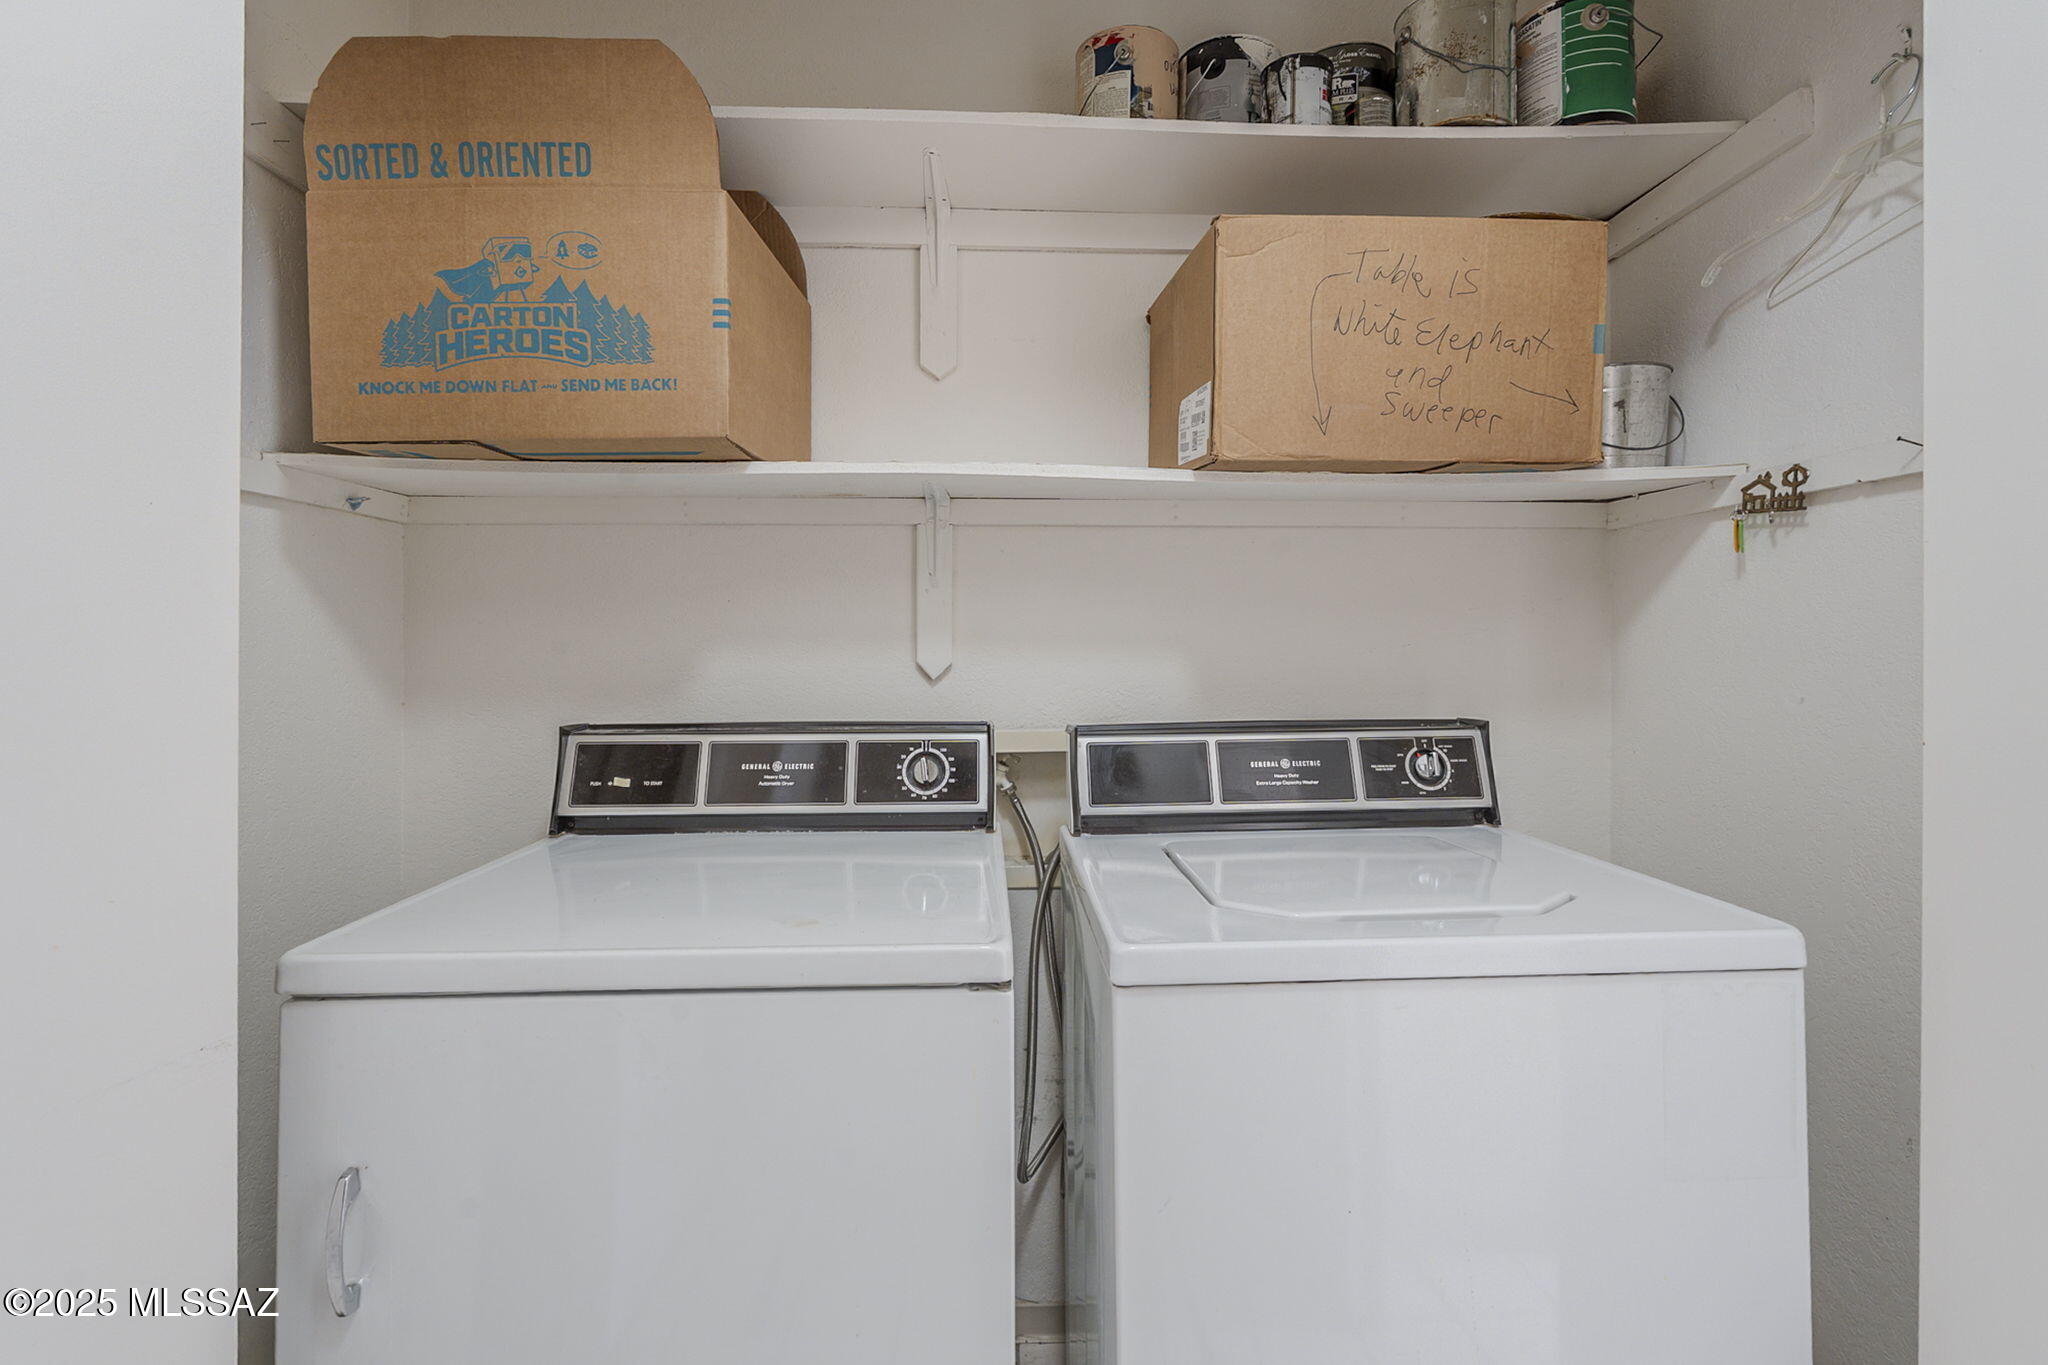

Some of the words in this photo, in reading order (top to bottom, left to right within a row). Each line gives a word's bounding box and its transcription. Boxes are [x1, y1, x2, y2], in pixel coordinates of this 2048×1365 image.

[315, 142, 420, 181] SORTED
[430, 142, 449, 179] &
[457, 141, 592, 179] ORIENTED
[1346, 248, 1432, 298] Table
[450, 306, 575, 329] CARTON
[1333, 300, 1406, 346] White
[1415, 317, 1555, 363] Elephant
[438, 328, 588, 365] HEROES
[358, 381, 416, 395] KNOCK
[419, 380, 441, 394] ME
[445, 380, 497, 394] DOWN
[502, 379, 538, 393] FLAT
[561, 379, 601, 392] SEND
[605, 379, 627, 391] ME
[631, 378, 678, 391] BACK!
